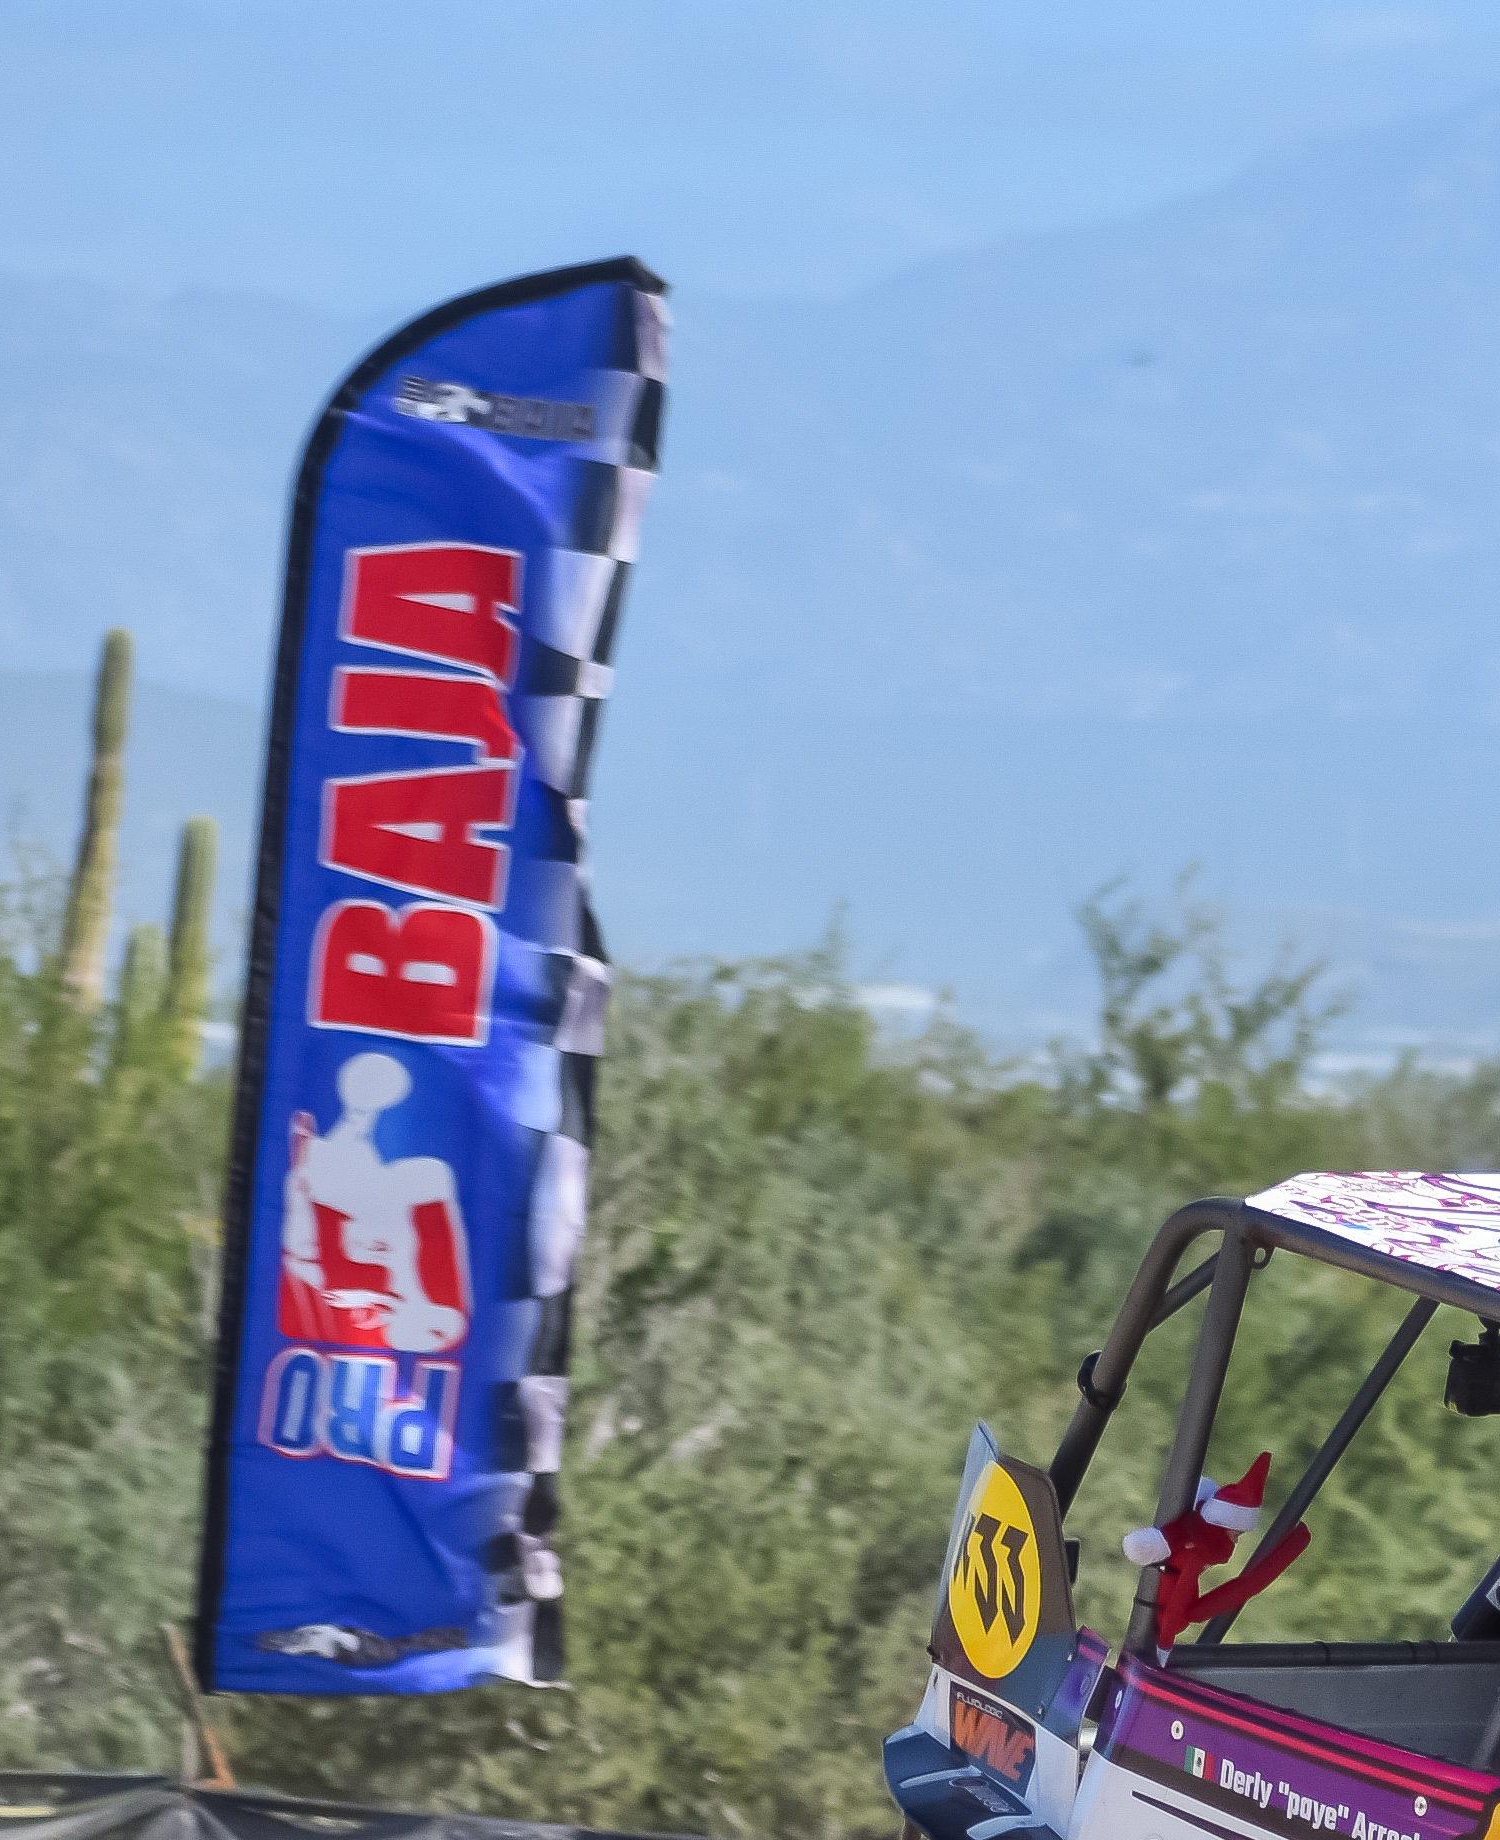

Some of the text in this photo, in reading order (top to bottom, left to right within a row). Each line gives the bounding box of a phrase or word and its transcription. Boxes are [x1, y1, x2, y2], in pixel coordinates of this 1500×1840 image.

[307, 540, 525, 1048] BAJA
[258, 1345, 462, 1481] PRO
[955, 1702, 1035, 1781] WAVE
[1220, 1758, 1273, 1809] Derly
